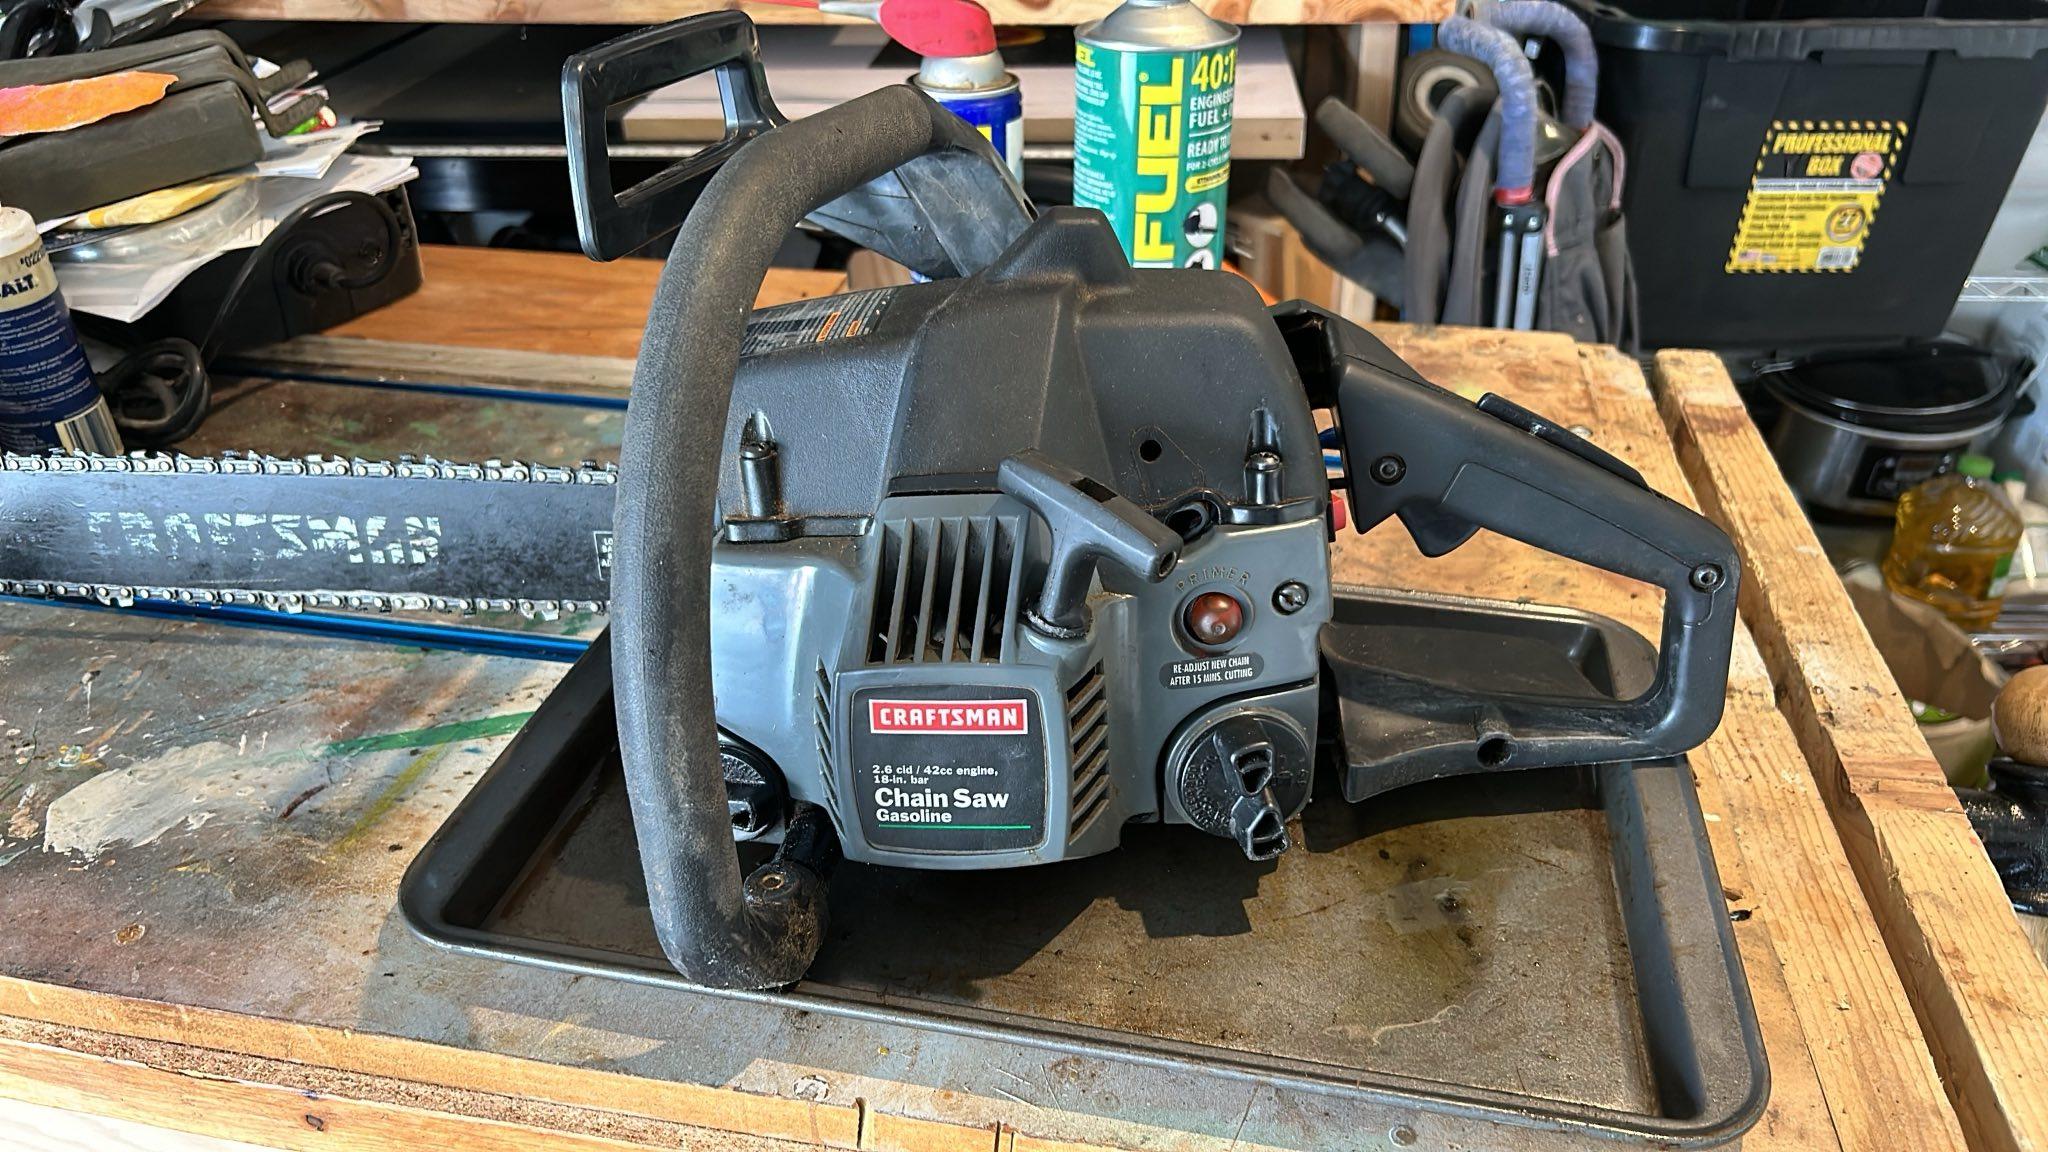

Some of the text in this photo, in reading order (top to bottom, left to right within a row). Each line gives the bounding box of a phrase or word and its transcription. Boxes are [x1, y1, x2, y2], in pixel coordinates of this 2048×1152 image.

[1189, 109, 1219, 129] FUEL
[1187, 138, 1219, 158] READY
[1772, 132, 1892, 154] PROFESSIONAL
[1133, 58, 1184, 261] FUEL
[1806, 155, 1845, 176] BOX
[0, 273, 35, 298] ALT
[1177, 566, 1250, 593] PRIMER
[1173, 660, 1210, 674] RE-ADJUST
[1211, 658, 1227, 670] NEW
[1169, 667, 1253, 686] AFTER 15 MINS. CUTTING
[879, 707, 1018, 727] CRAFTSMAN
[872, 764, 893, 775] 2.6
[915, 765, 921, 776] /
[923, 765, 953, 776] 42cc
[956, 765, 999, 777] engine,
[873, 774, 930, 785] 18-in. bar
[874, 786, 1010, 808] Chain Saw
[875, 808, 953, 823] Gasoline
